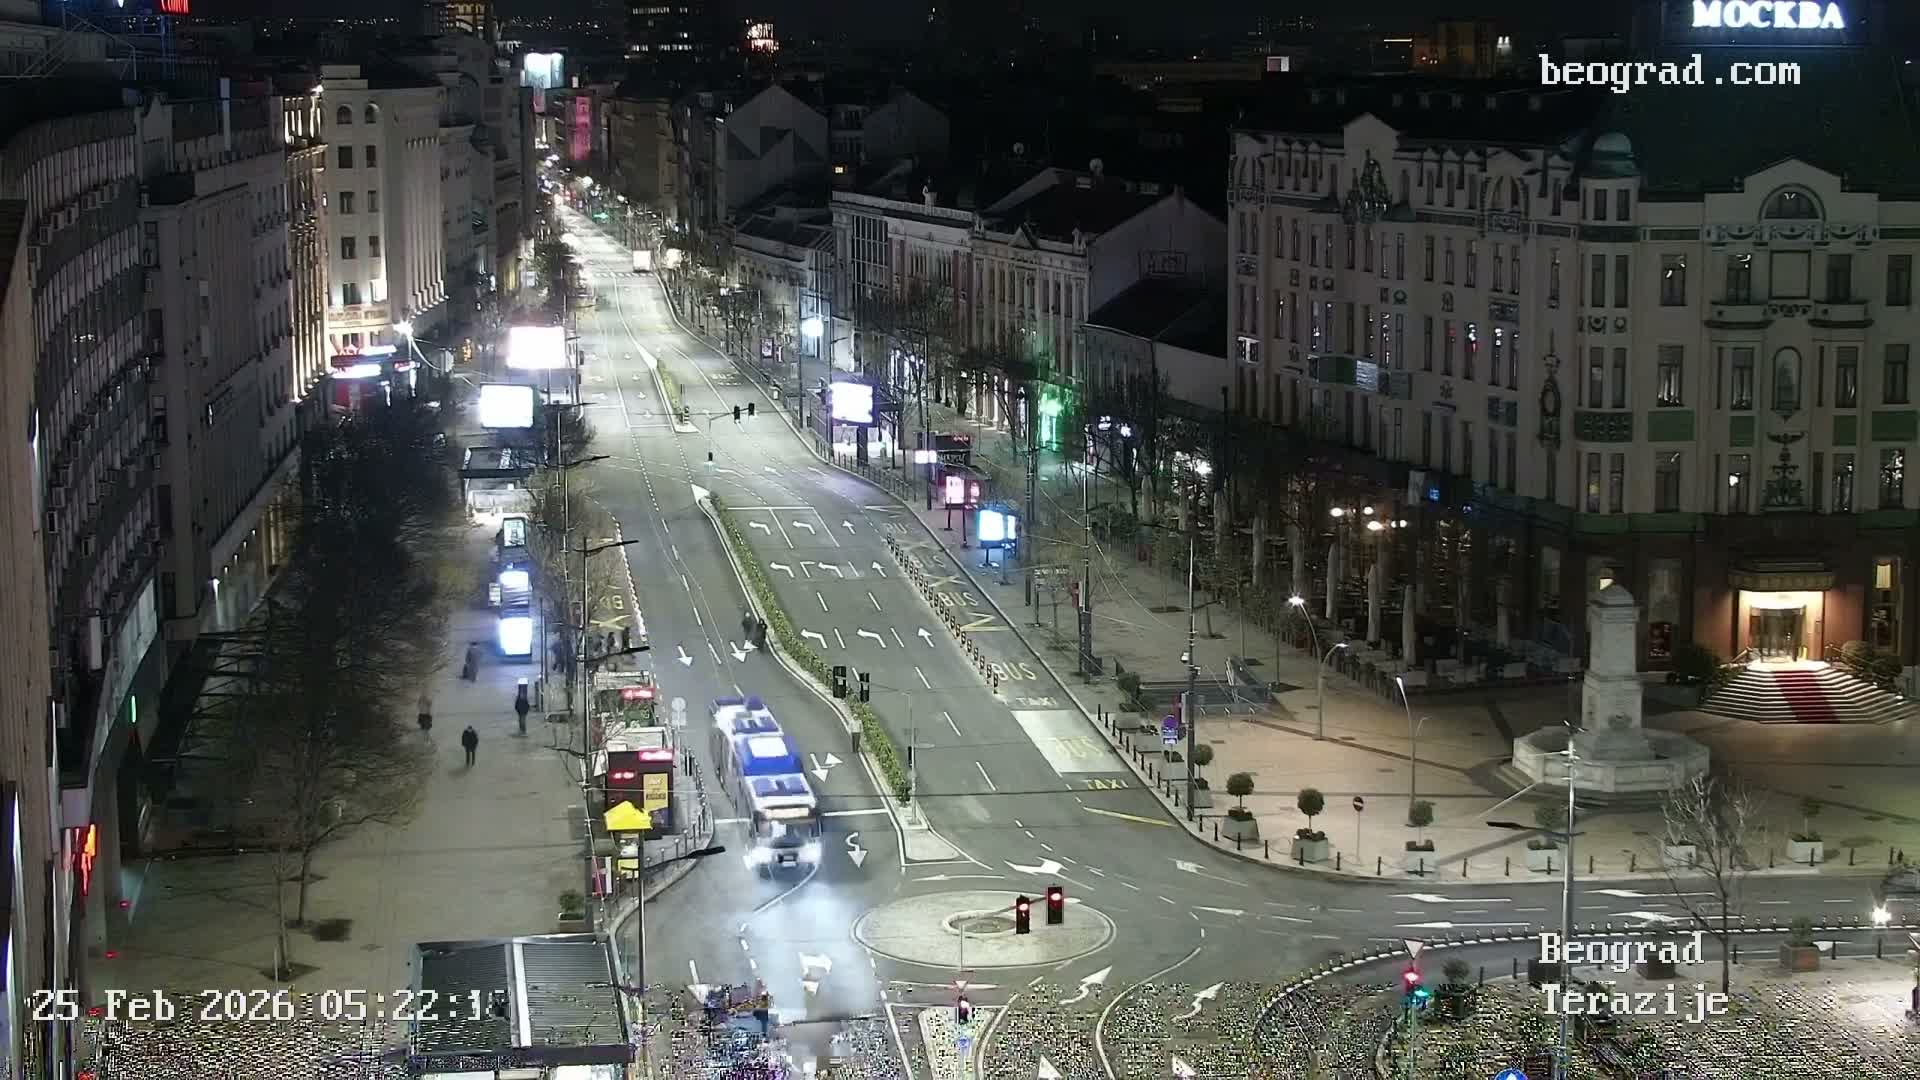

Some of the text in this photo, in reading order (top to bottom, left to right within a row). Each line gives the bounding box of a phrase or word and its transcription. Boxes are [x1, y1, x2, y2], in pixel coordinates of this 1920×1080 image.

[1691, 0, 1844, 28] МОСКВА
[938, 591, 979, 607] BUS
[992, 662, 1037, 681] BUS
[1015, 696, 1057, 706] TAXI
[1080, 779, 1129, 790] TAXI
